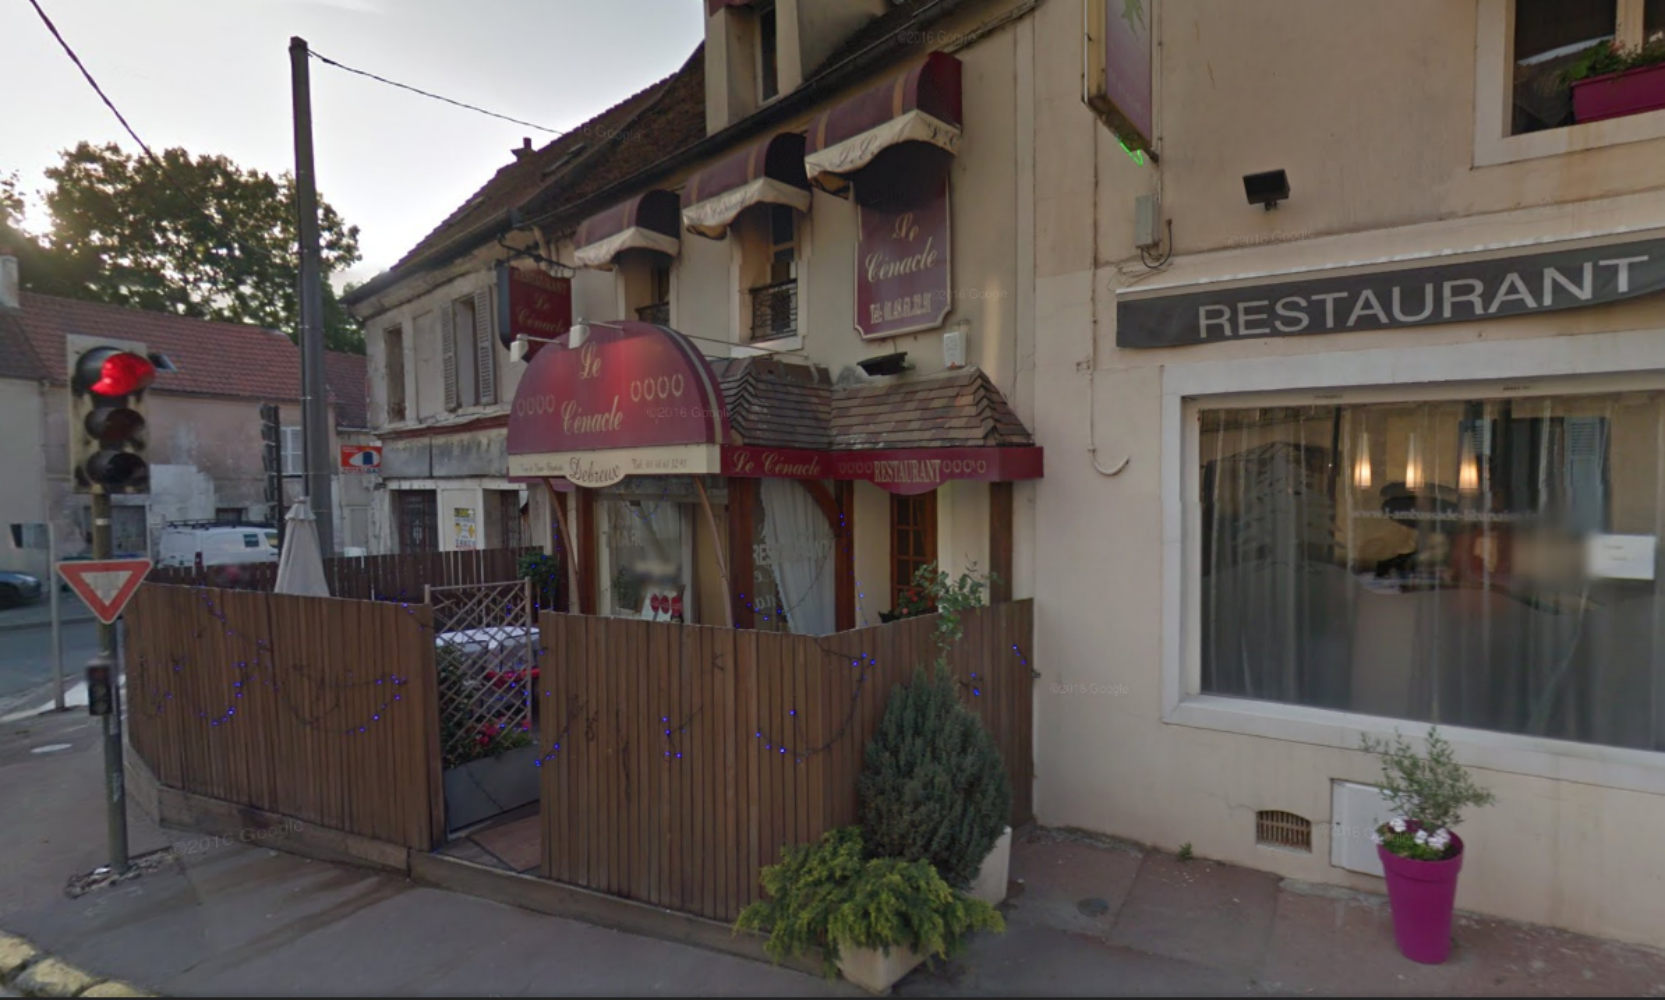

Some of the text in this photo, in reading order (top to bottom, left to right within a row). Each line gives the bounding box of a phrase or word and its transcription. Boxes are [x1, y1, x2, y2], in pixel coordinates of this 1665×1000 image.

[892, 211, 920, 242] Le
[865, 236, 938, 284] Cénacle
[1199, 253, 1650, 338] RESTAURANT
[580, 342, 601, 380] Le
[561, 395, 623, 435] Cénacle
[732, 450, 822, 476] Le Cénacle
[872, 459, 942, 484] RESTAURANT
